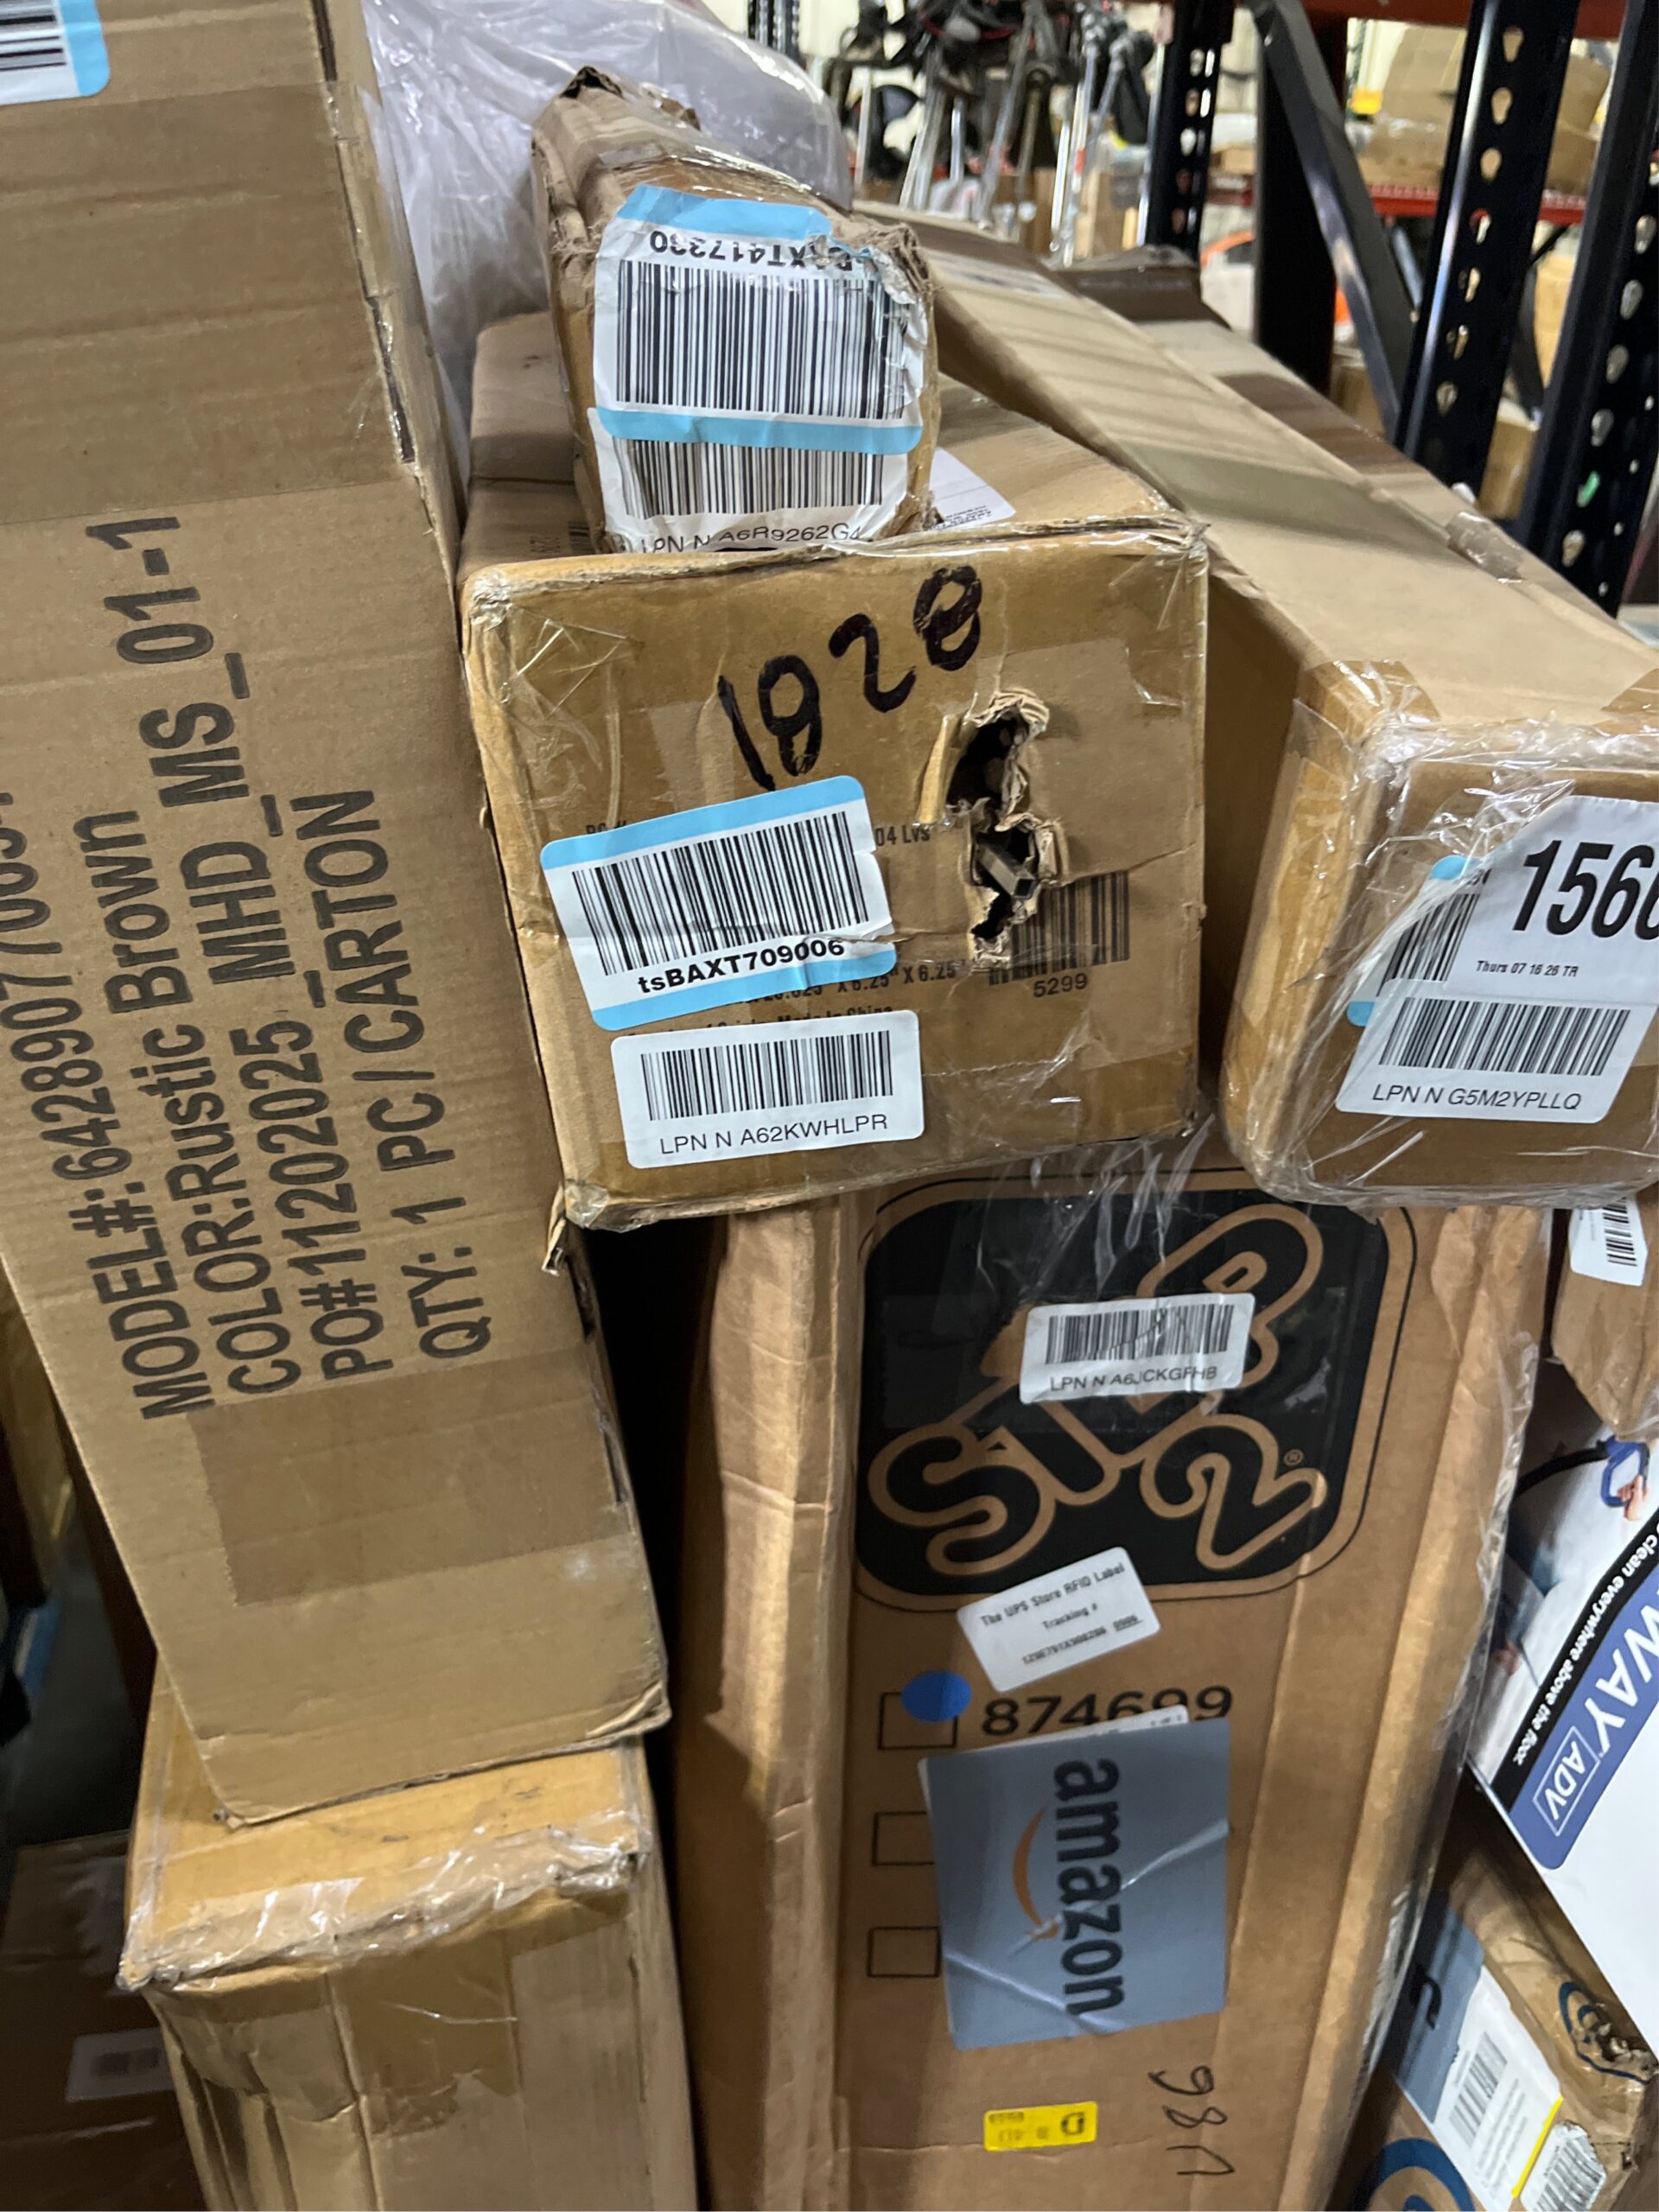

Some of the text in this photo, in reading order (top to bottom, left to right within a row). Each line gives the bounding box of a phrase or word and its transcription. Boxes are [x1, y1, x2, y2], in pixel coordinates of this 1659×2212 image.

[73, 810, 194, 1014] Brown
[638, 938, 845, 994] tsBAXT709006
[1033, 973, 1089, 998] 5299
[1371, 1084, 1582, 1111] LPN N G5M2YPLLQ
[659, 1114, 888, 1154] LPN N A62KWHLPR
[391, 1197, 467, 1225] 1
[400, 1246, 492, 1359] QTY:
[1050, 1376, 1087, 1391] LPN
[1092, 1376, 1105, 1386] N
[1621, 1534, 1658, 1578] clean
[981, 1562, 1125, 1627] The UPS Store RFID Label
[1042, 1605, 1090, 1630] Tracking
[1570, 1574, 1624, 1662] everywhere
[1546, 1661, 1576, 1706] above
[1531, 1704, 1554, 1732] the
[1544, 1740, 1586, 1820] ADV
[1054, 1758, 1125, 2016] amazon
